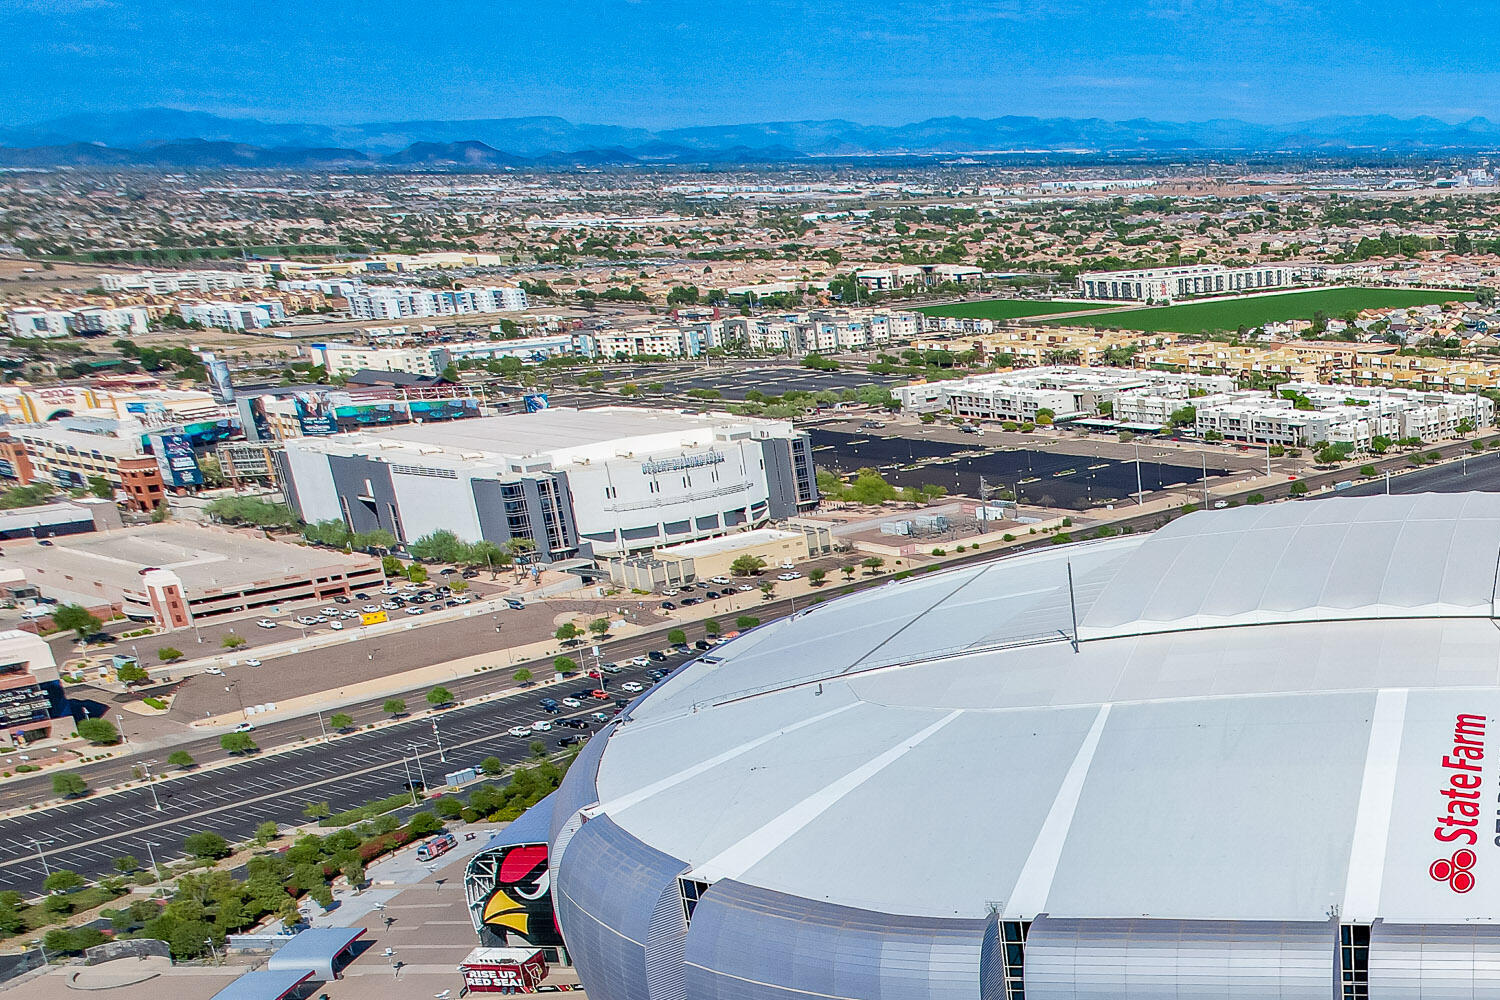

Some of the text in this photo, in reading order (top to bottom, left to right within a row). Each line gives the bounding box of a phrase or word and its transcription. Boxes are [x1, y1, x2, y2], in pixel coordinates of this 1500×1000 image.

[469, 970, 516, 979] RISE UP
[467, 978, 523, 987] RED SEA!
